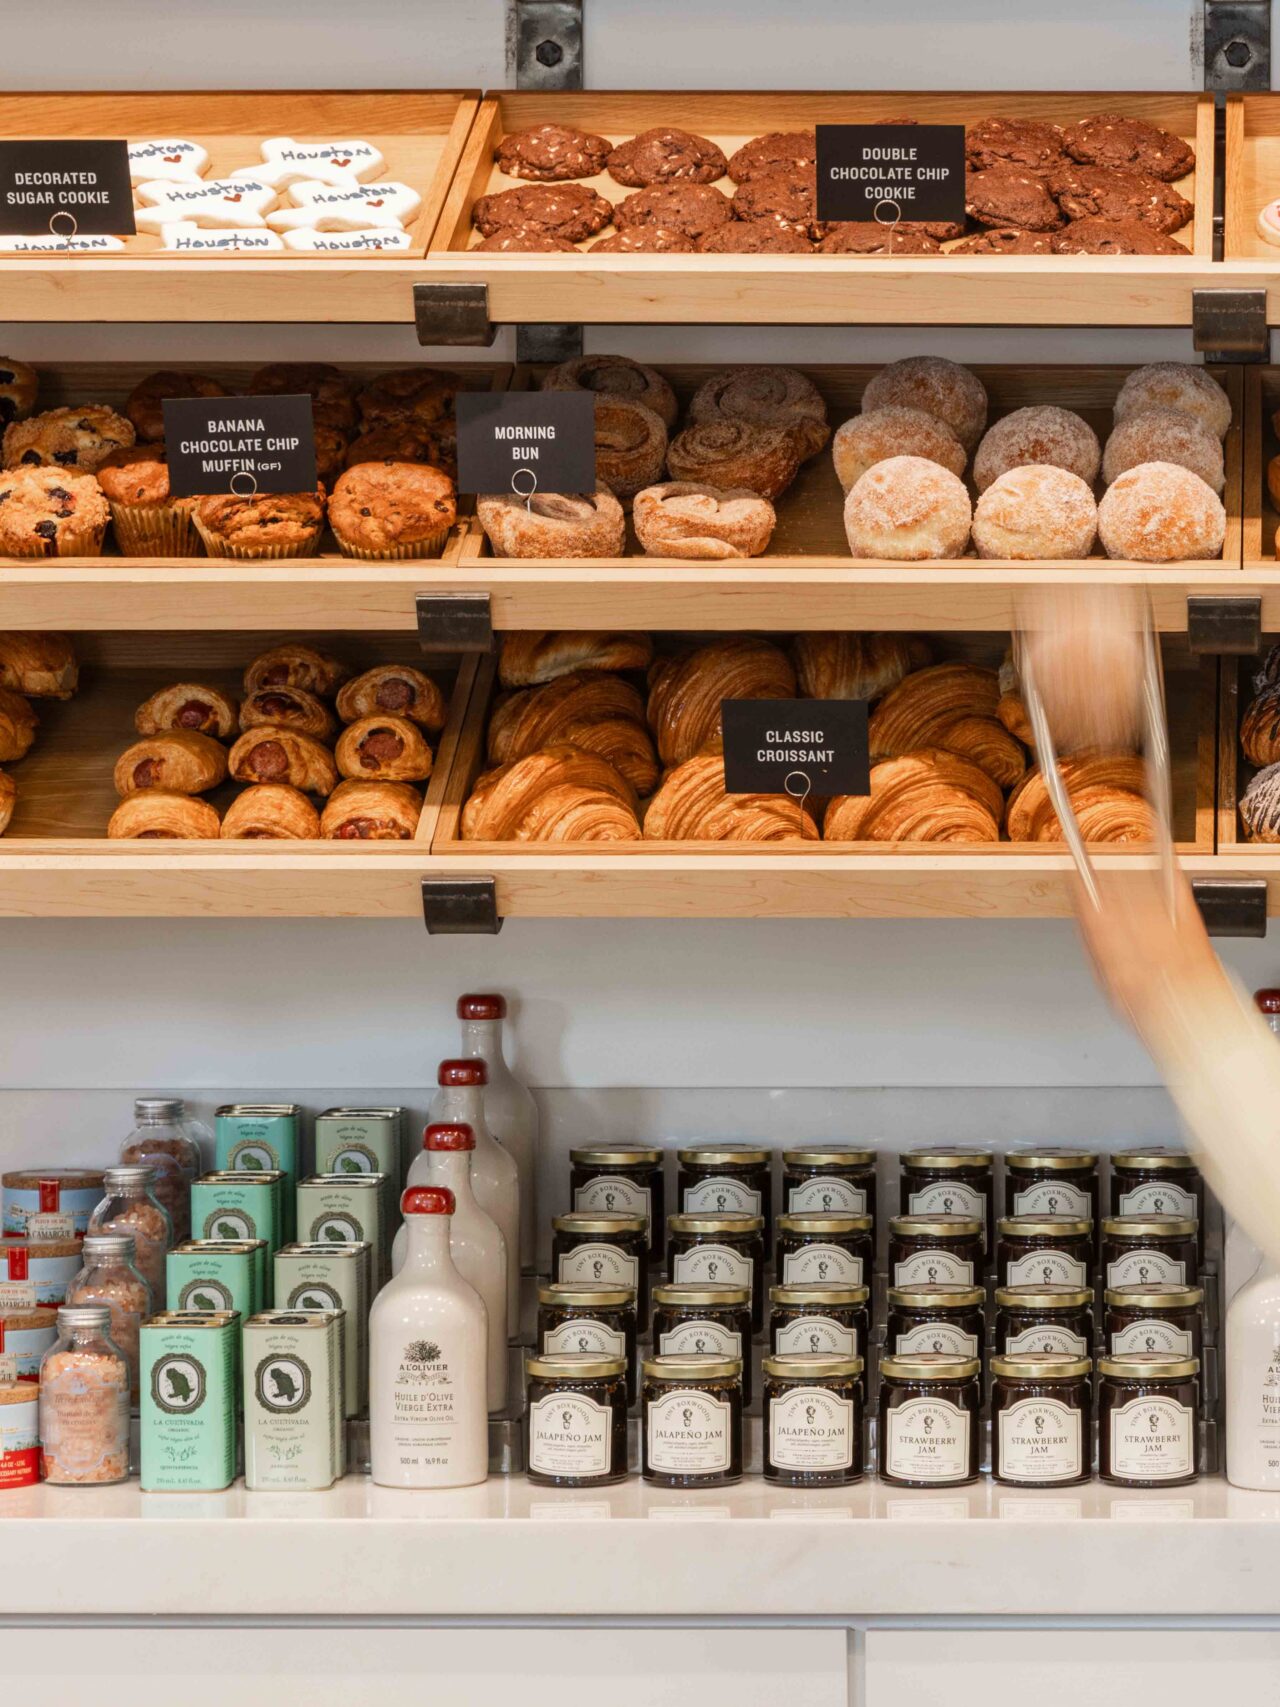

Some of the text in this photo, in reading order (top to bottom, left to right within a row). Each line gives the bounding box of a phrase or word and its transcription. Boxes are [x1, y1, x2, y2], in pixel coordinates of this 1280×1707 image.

[281, 146, 372, 161] Houston
[862, 148, 917, 160] DOUBLE
[15, 172, 97, 185] DECORATED
[830, 167, 950, 180] CHOCOLATE CHIP
[6, 191, 110, 204] SUGAR COOKIE
[166, 182, 263, 202] Houston
[313, 186, 397, 203] Houston
[864, 186, 916, 199] COOKIE
[176, 234, 269, 249] Houston
[208, 419, 265, 433] BANANA
[495, 426, 556, 440] MORNING
[180, 438, 299, 454] CHOCOLATE CHIP
[512, 447, 539, 460] BUN
[202, 458, 282, 472] MUFFIN (GF)
[766, 731, 824, 743] CLASSIC
[757, 750, 835, 762] CROISSANT
[600, 1186, 632, 1205] BOXWOODS
[712, 1188, 743, 1208] BOXWOODS
[817, 1187, 849, 1207] BOXWOODS
[938, 1191, 970, 1211] BOXWOODS
[1042, 1190, 1074, 1210] BOXWOODS
[1147, 1191, 1180, 1211] BOXWOODS
[588, 1254, 620, 1273] BOXWOODS
[703, 1254, 735, 1276] BOXWOODS
[813, 1254, 845, 1275] BOXWOODS
[922, 1259, 955, 1280] BOXWOODS
[1037, 1259, 1069, 1279] BOXWOODS
[1133, 1259, 1167, 1279] BOXWOODS
[573, 1330, 606, 1351] BOXWOODS
[689, 1331, 723, 1352] BOXWOODS
[804, 1327, 838, 1348] BOXWOODS
[1140, 1329, 1173, 1349] BOXWOODS
[394, 1392, 454, 1401] HUILE D'OLIVE
[395, 1402, 453, 1411] VIERGE EXTRA
[557, 1402, 591, 1426] BOXWOODS
[677, 1400, 711, 1422] BOXWOODS
[800, 1398, 834, 1420] BOXWOODS
[918, 1408, 951, 1430] BOXWOODS
[1028, 1408, 1063, 1429] BOXWOODS
[1143, 1406, 1176, 1427] BOXWOODS
[536, 1430, 602, 1442] JALAPEÑO JAM
[655, 1429, 723, 1439] JALAPEÑO JAM
[778, 1426, 845, 1437] JALAPEÑO JAM
[1124, 1435, 1181, 1443] STRAWBERRY
[899, 1436, 956, 1445] STRAWBERRY
[1011, 1436, 1068, 1445] STRAWBERRY
[918, 1446, 936, 1454] JAM
[1030, 1446, 1048, 1454] JAM
[400, 1457, 411, 1465] 500
